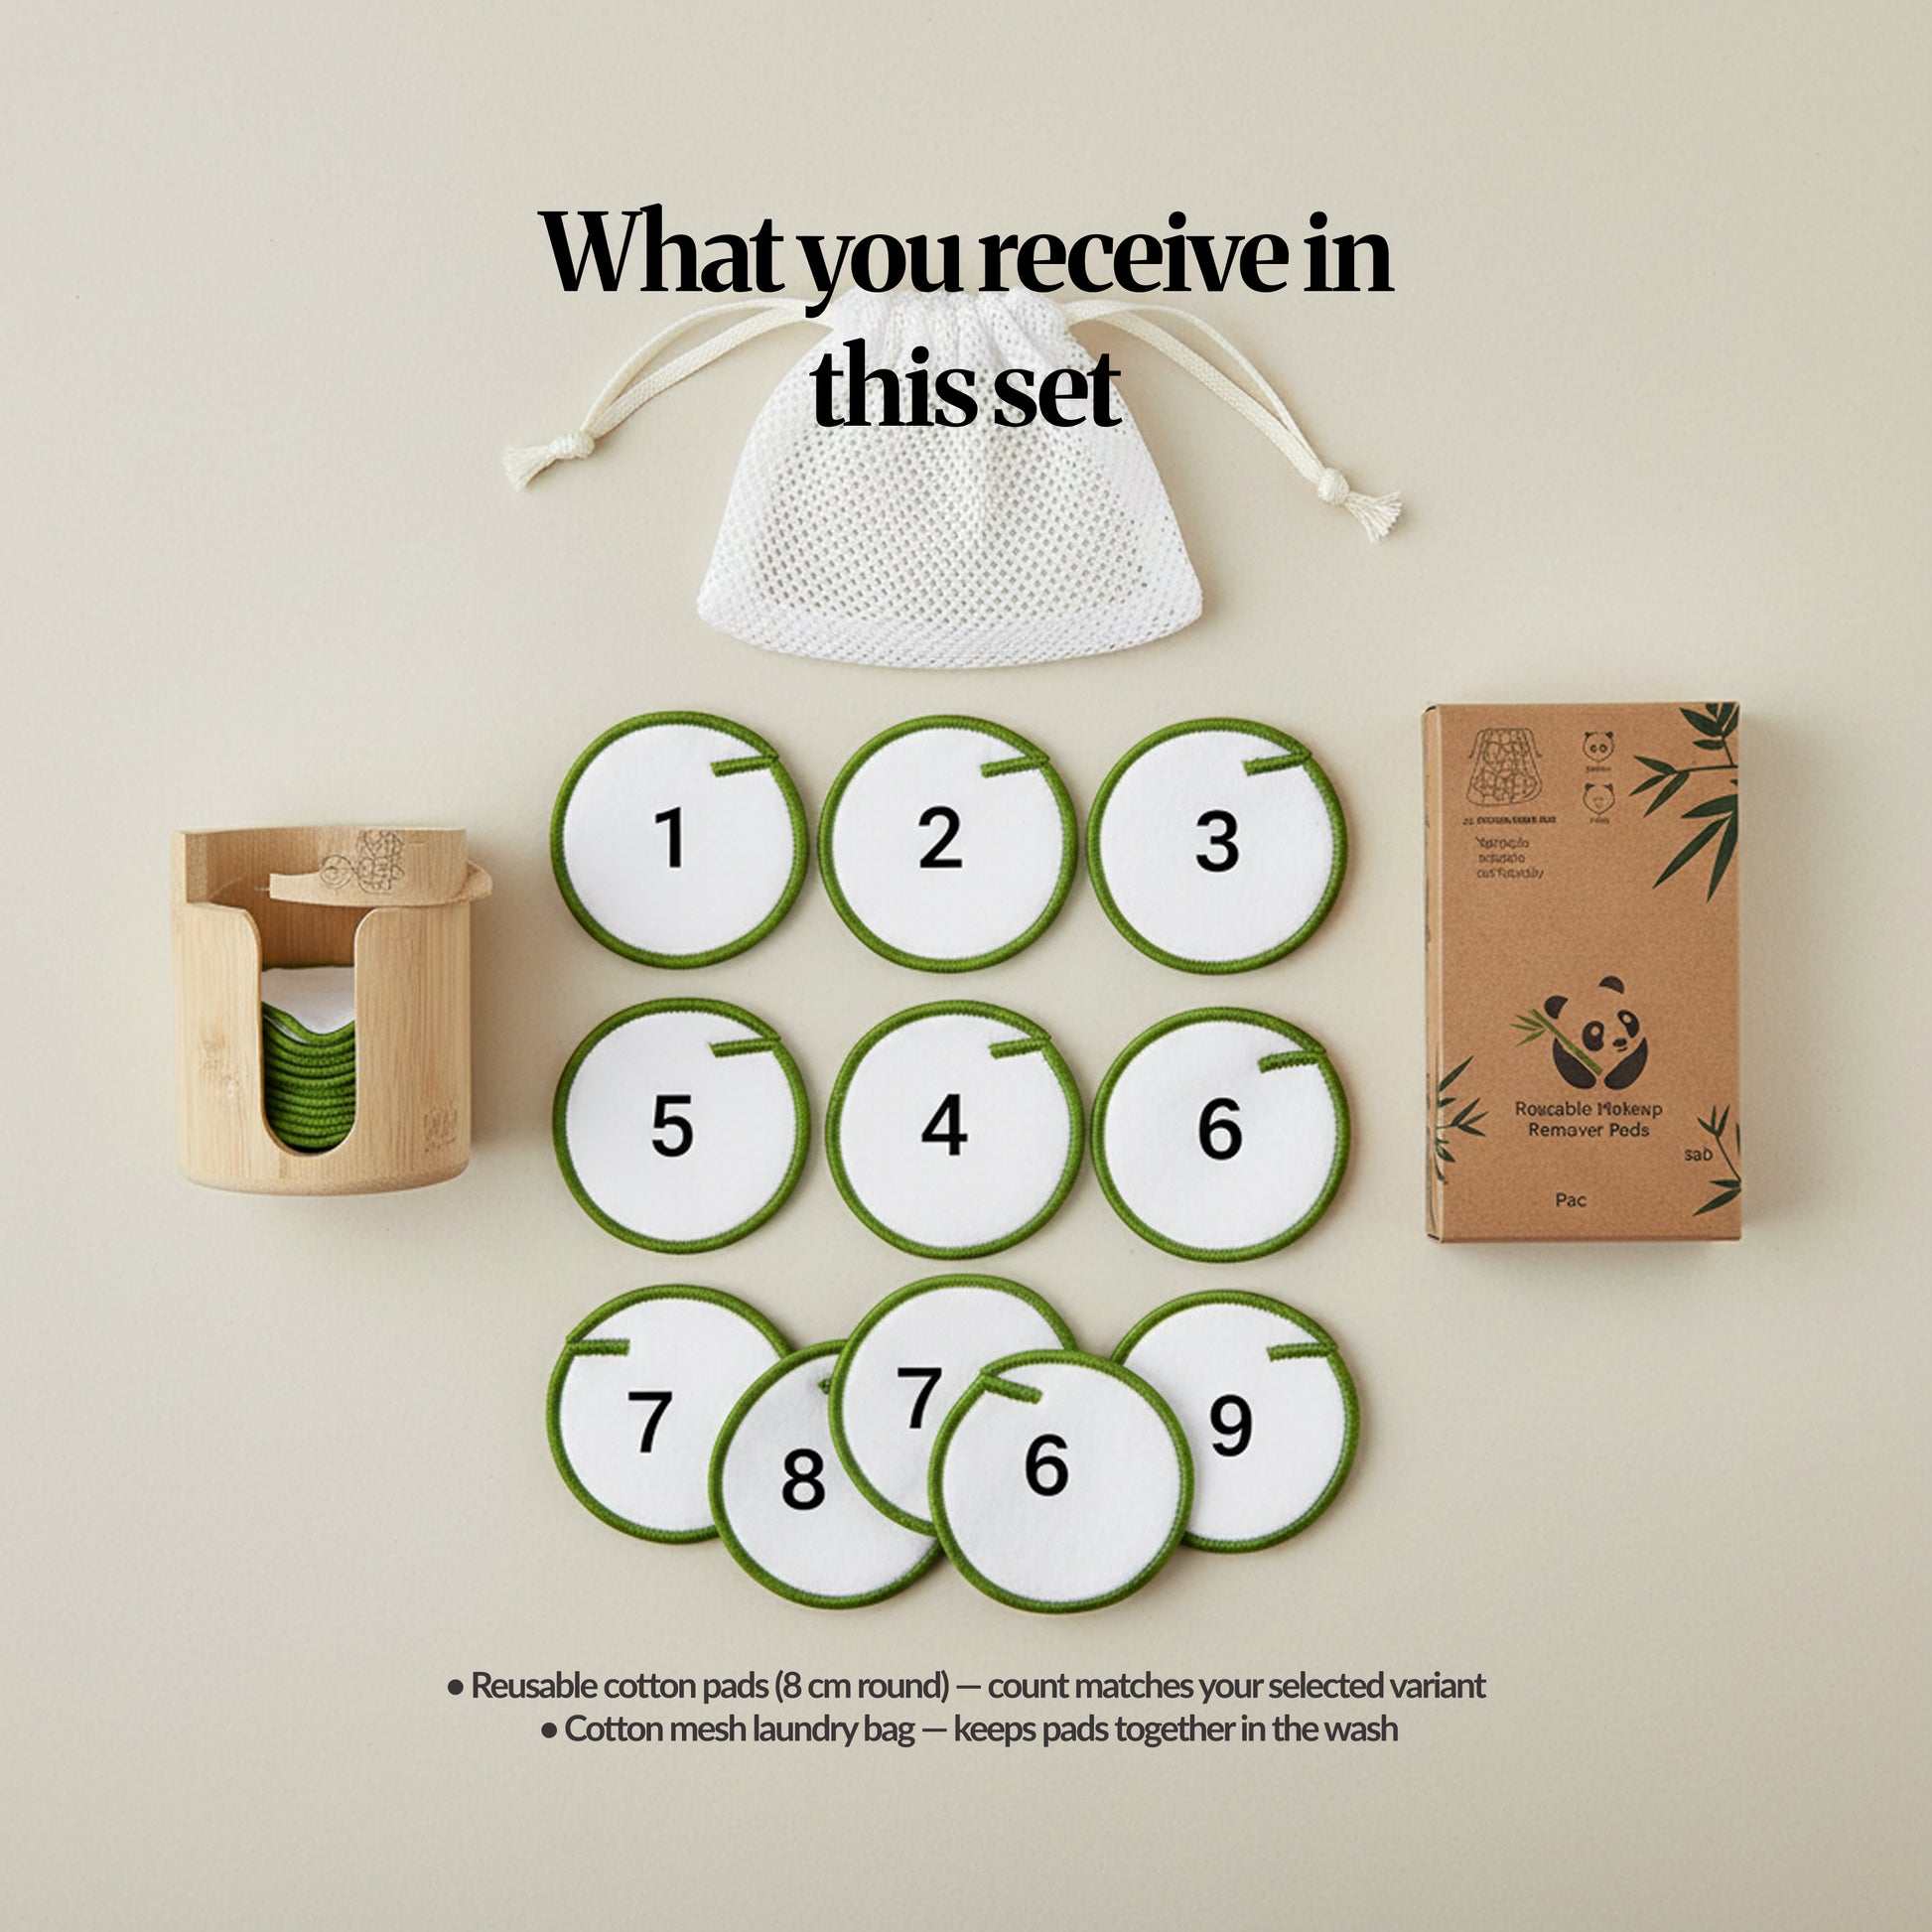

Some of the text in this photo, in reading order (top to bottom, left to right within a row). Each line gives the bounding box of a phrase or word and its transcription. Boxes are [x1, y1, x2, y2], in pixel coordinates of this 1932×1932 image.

[656, 807, 680, 867] 1
[919, 807, 961, 868] 2
[1197, 810, 1238, 872] 3
[653, 1095, 692, 1157] 5
[922, 1094, 967, 1155] 4
[1199, 1098, 1241, 1160] 6
[1556, 1191, 1587, 1208] Pac
[628, 1392, 672, 1452] 7
[898, 1368, 942, 1429] 7
[1210, 1395, 1252, 1456] 9
[782, 1449, 825, 1510] 8
[1026, 1435, 1068, 1496] 6
